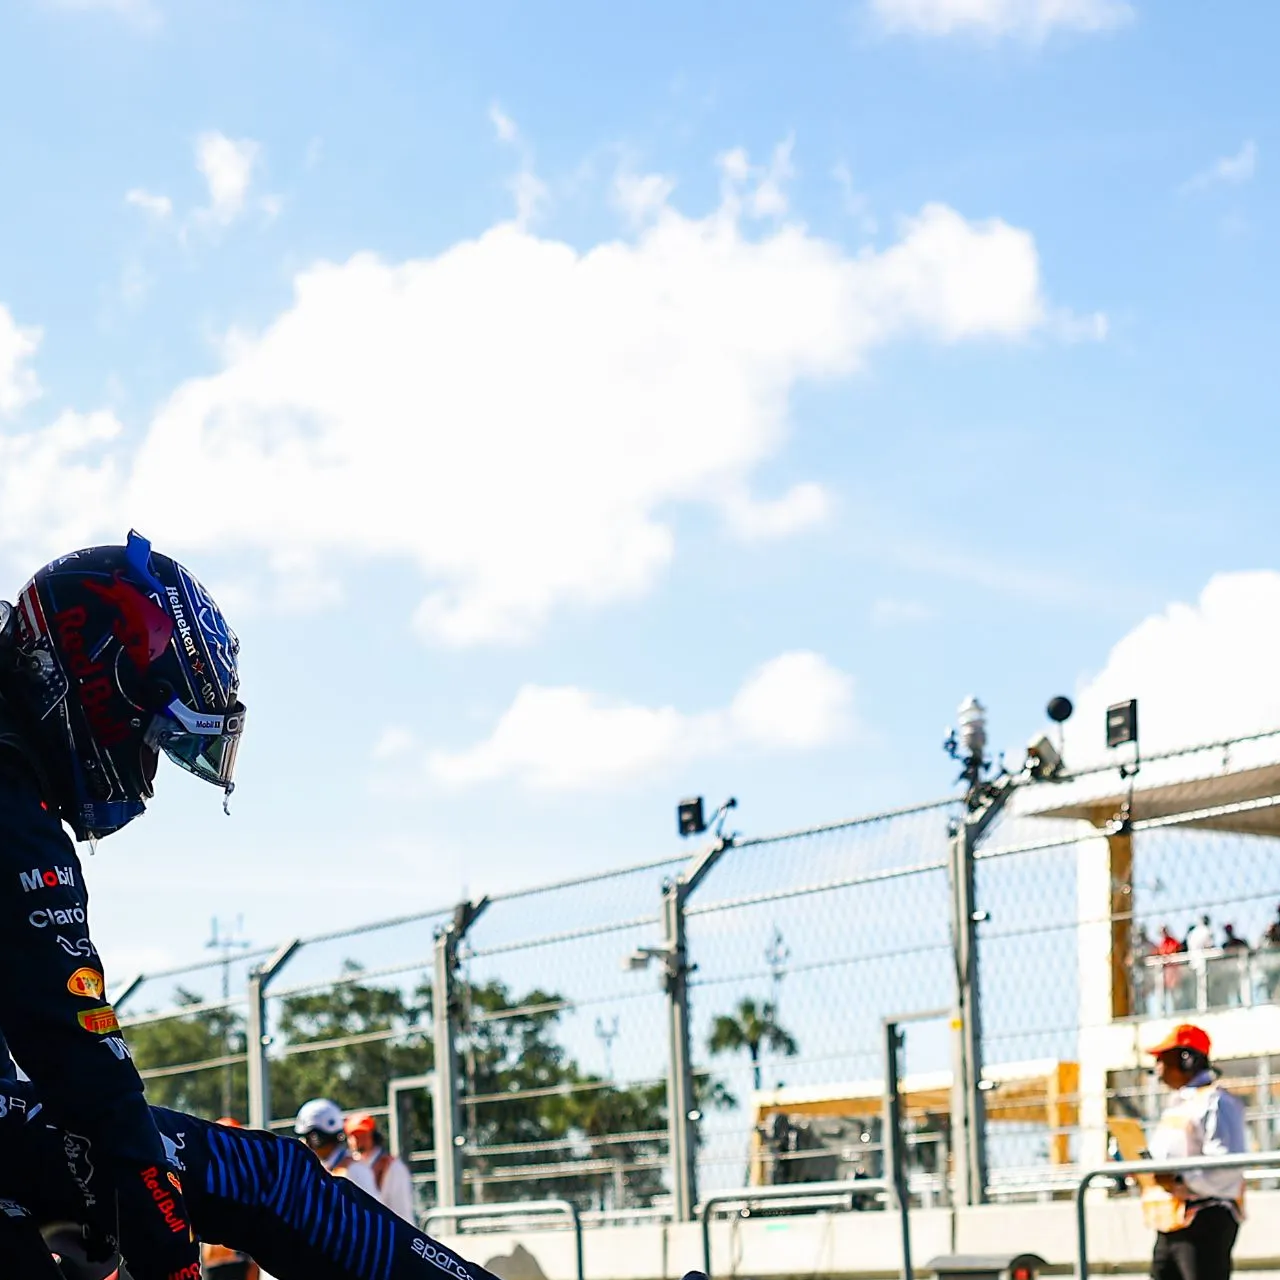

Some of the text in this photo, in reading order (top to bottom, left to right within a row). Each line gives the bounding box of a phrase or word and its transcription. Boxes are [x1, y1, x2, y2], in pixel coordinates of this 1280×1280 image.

[165, 585, 199, 657] Heineken
[19, 866, 74, 892] Mobil
[29, 903, 84, 928] Claro
[137, 1164, 188, 1233] Red Bull
